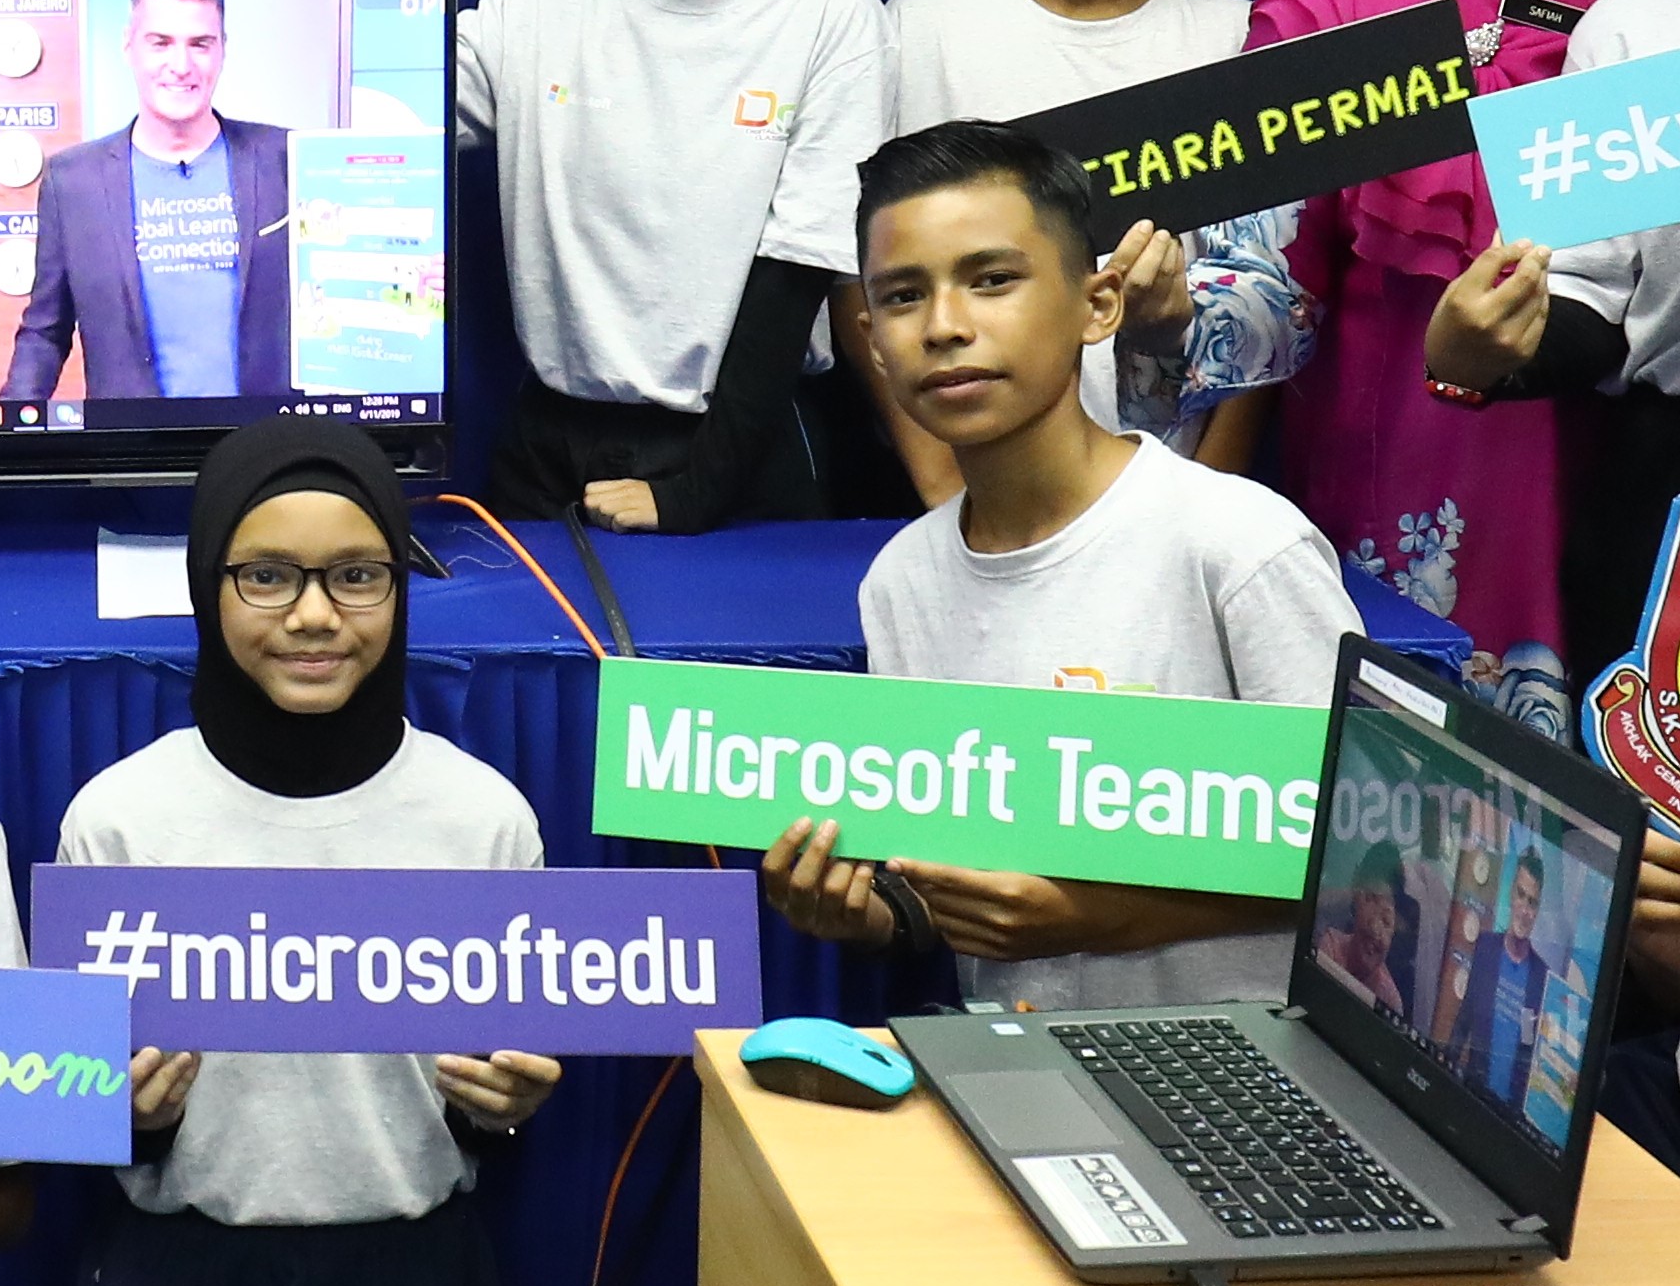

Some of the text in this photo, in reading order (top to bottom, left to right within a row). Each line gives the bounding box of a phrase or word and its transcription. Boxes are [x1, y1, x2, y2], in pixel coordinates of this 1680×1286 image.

[1256, 56, 1470, 154] PERMAI
[140, 192, 233, 218] Microsoft
[625, 704, 1320, 849] Microsoft Teams
[1620, 710, 1653, 764] AKHLAK
[77, 910, 717, 1006] #microsoftedu
